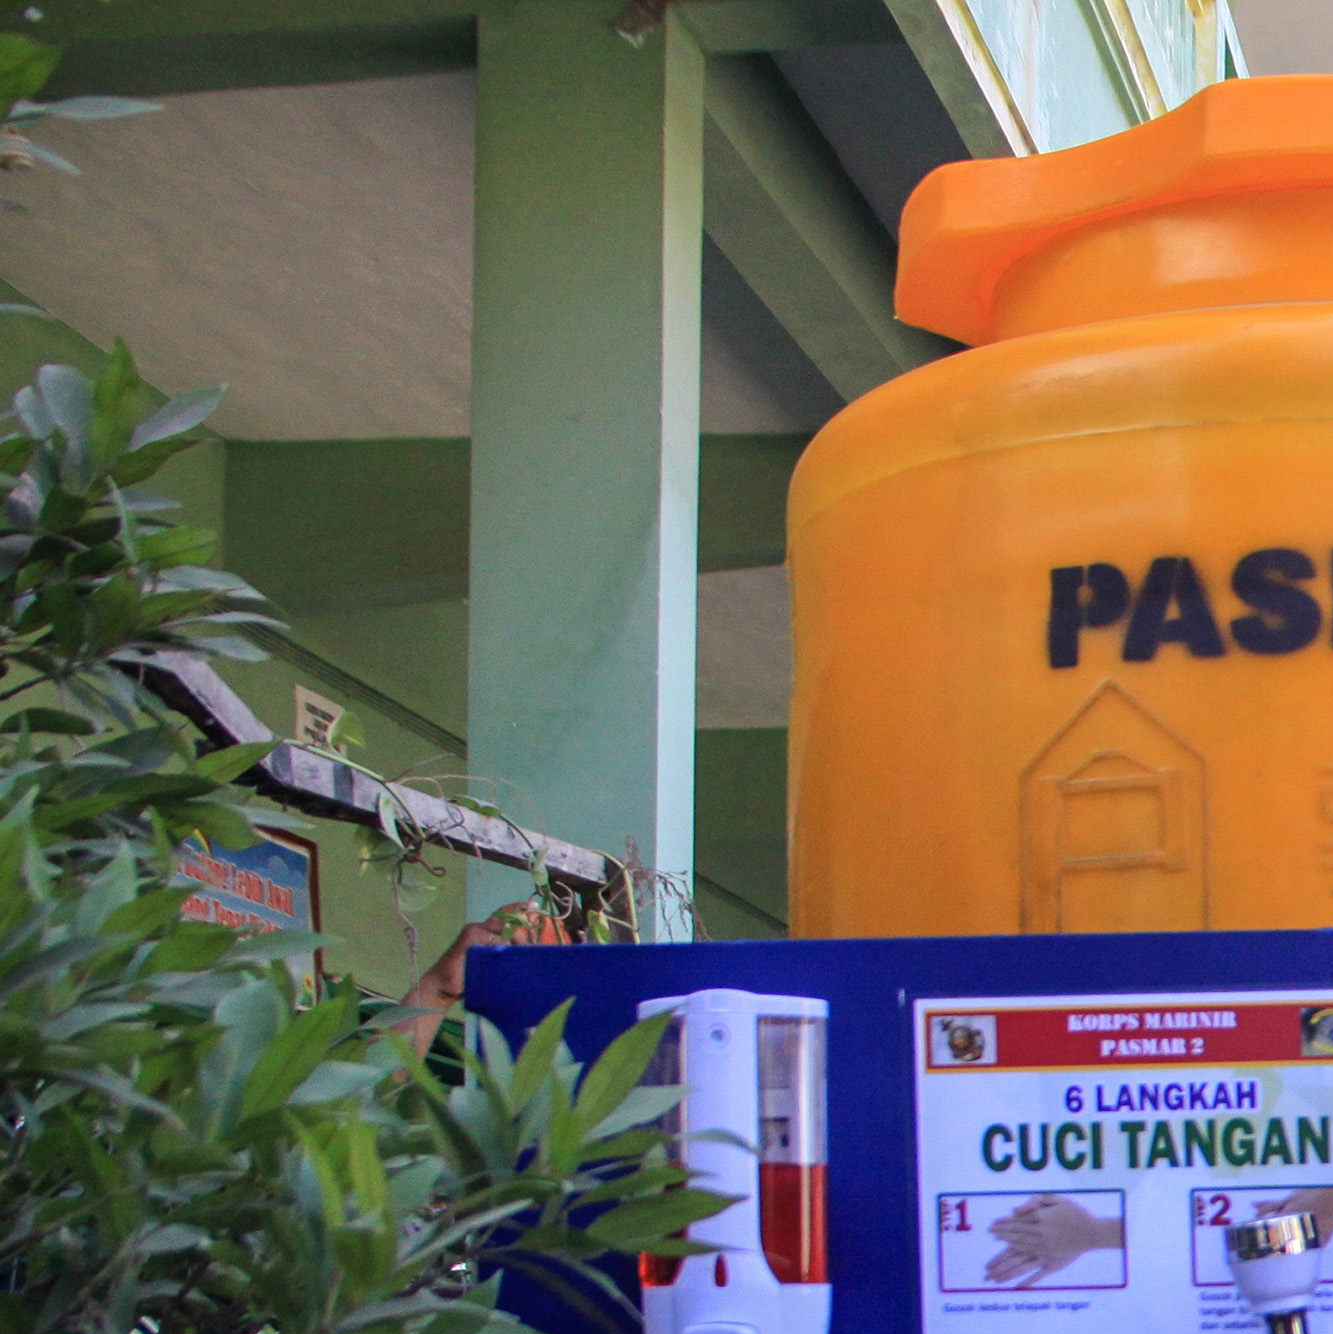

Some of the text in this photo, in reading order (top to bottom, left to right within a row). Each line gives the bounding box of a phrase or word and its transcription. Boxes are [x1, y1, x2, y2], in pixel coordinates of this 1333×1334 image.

[1067, 1010, 1238, 1032] KORPS MARINIR
[1099, 1037, 1206, 1057] PASMAR 2
[1065, 1081, 1258, 1113] 6 LANGKAH
[982, 1115, 1332, 1172] CUCI TANGAN
[954, 1198, 972, 1232] 1
[1209, 1193, 1232, 1227] 2
